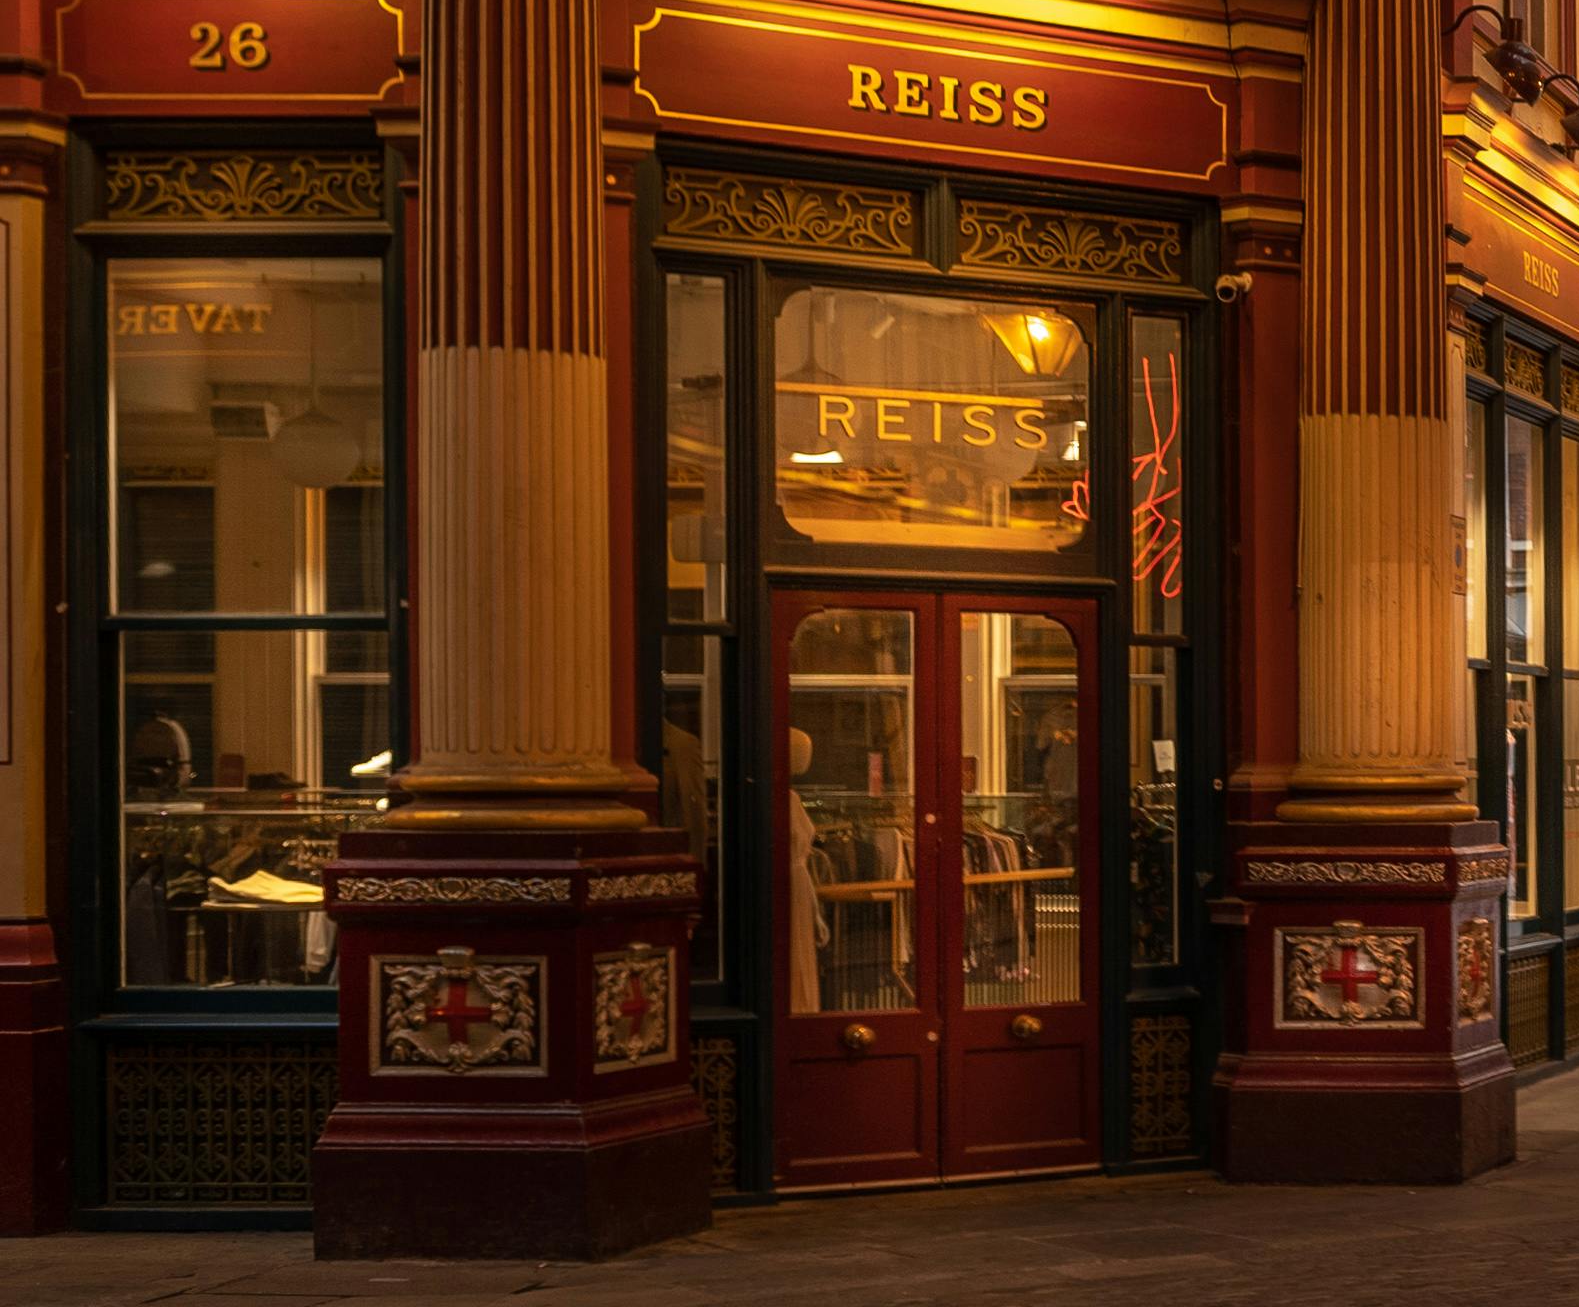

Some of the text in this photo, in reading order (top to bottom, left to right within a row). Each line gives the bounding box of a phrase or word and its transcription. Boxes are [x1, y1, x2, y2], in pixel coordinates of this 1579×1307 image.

[188, 22, 271, 71] 26
[846, 63, 1050, 131] REISS
[1523, 251, 1559, 298] REISS
[818, 395, 1048, 450] REISS
